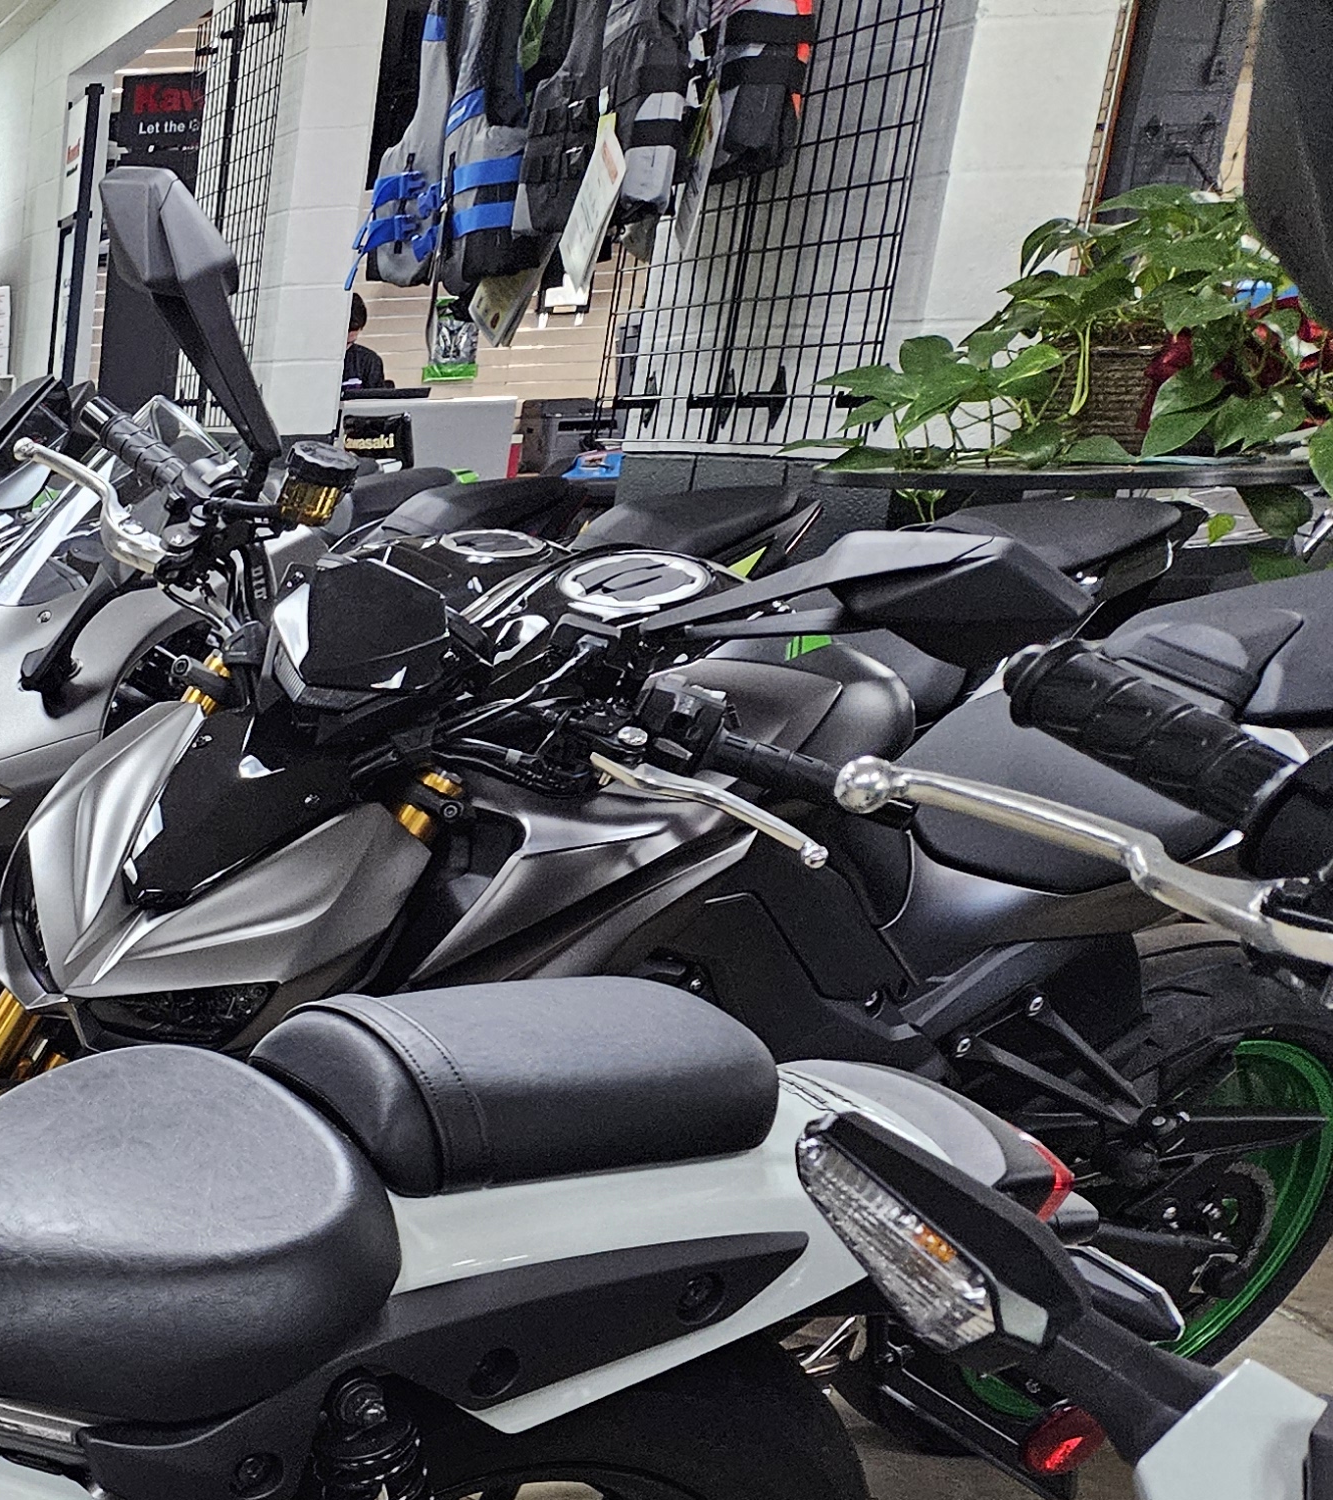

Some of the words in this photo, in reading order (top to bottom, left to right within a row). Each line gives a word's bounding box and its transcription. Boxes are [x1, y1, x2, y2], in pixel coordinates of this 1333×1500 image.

[138, 121, 160, 135] Let
[164, 120, 185, 133] the
[343, 432, 394, 450] awasaki
